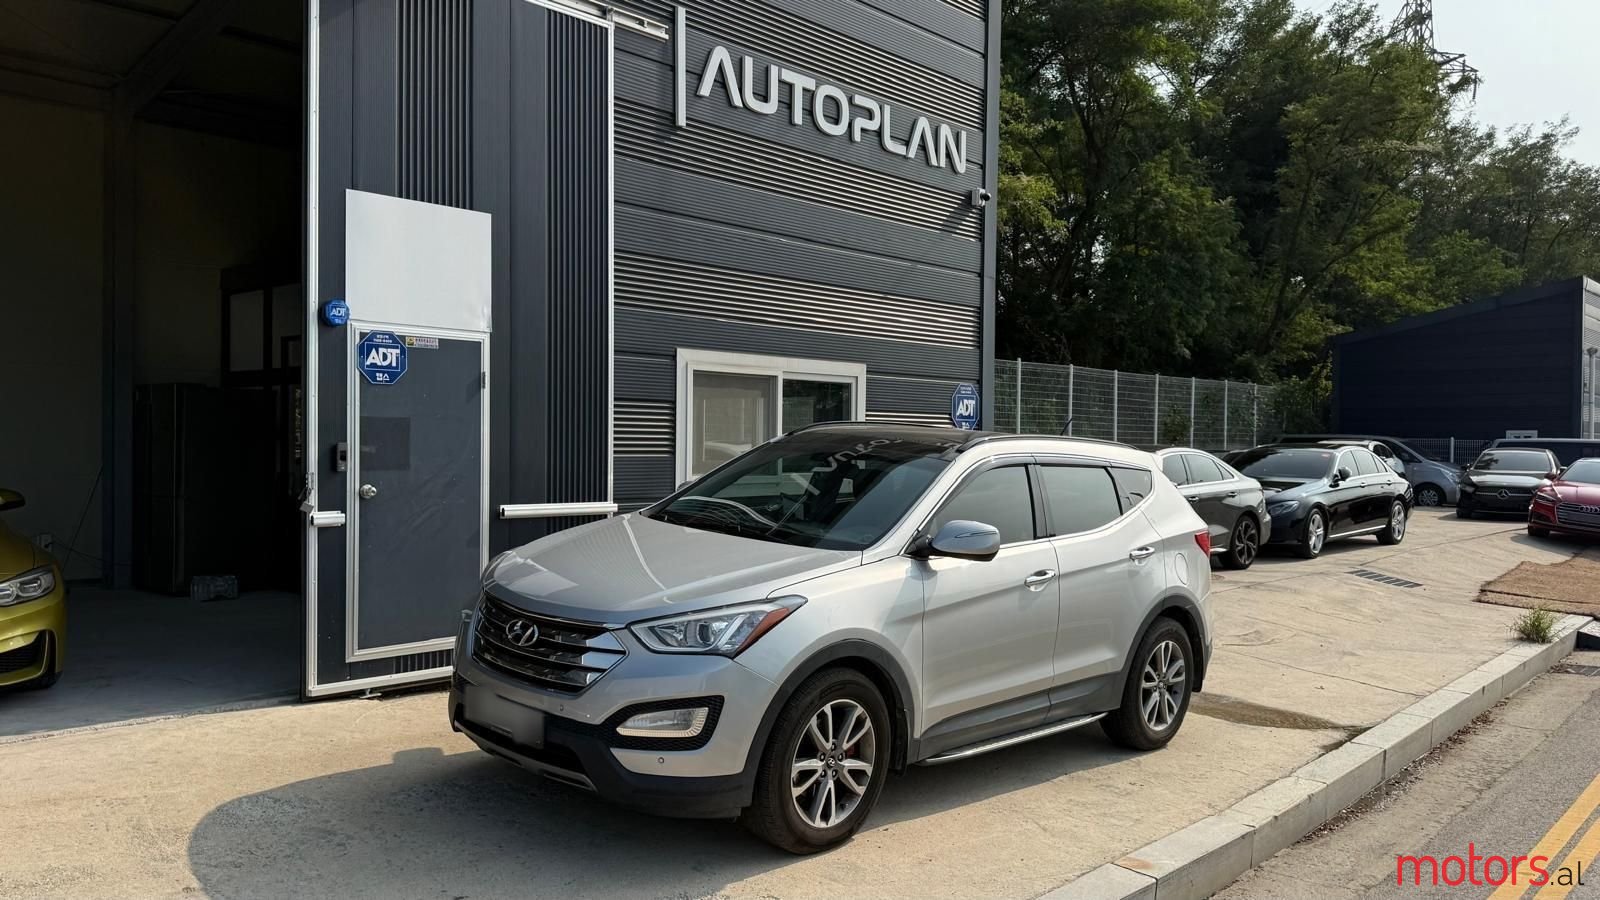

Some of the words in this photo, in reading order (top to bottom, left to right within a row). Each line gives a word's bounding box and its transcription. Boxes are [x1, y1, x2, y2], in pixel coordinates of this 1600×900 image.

[696, 45, 967, 174] AUTOPLAN
[330, 307, 346, 317] ADT
[366, 348, 400, 367] ADT
[956, 399, 975, 417] ADT
